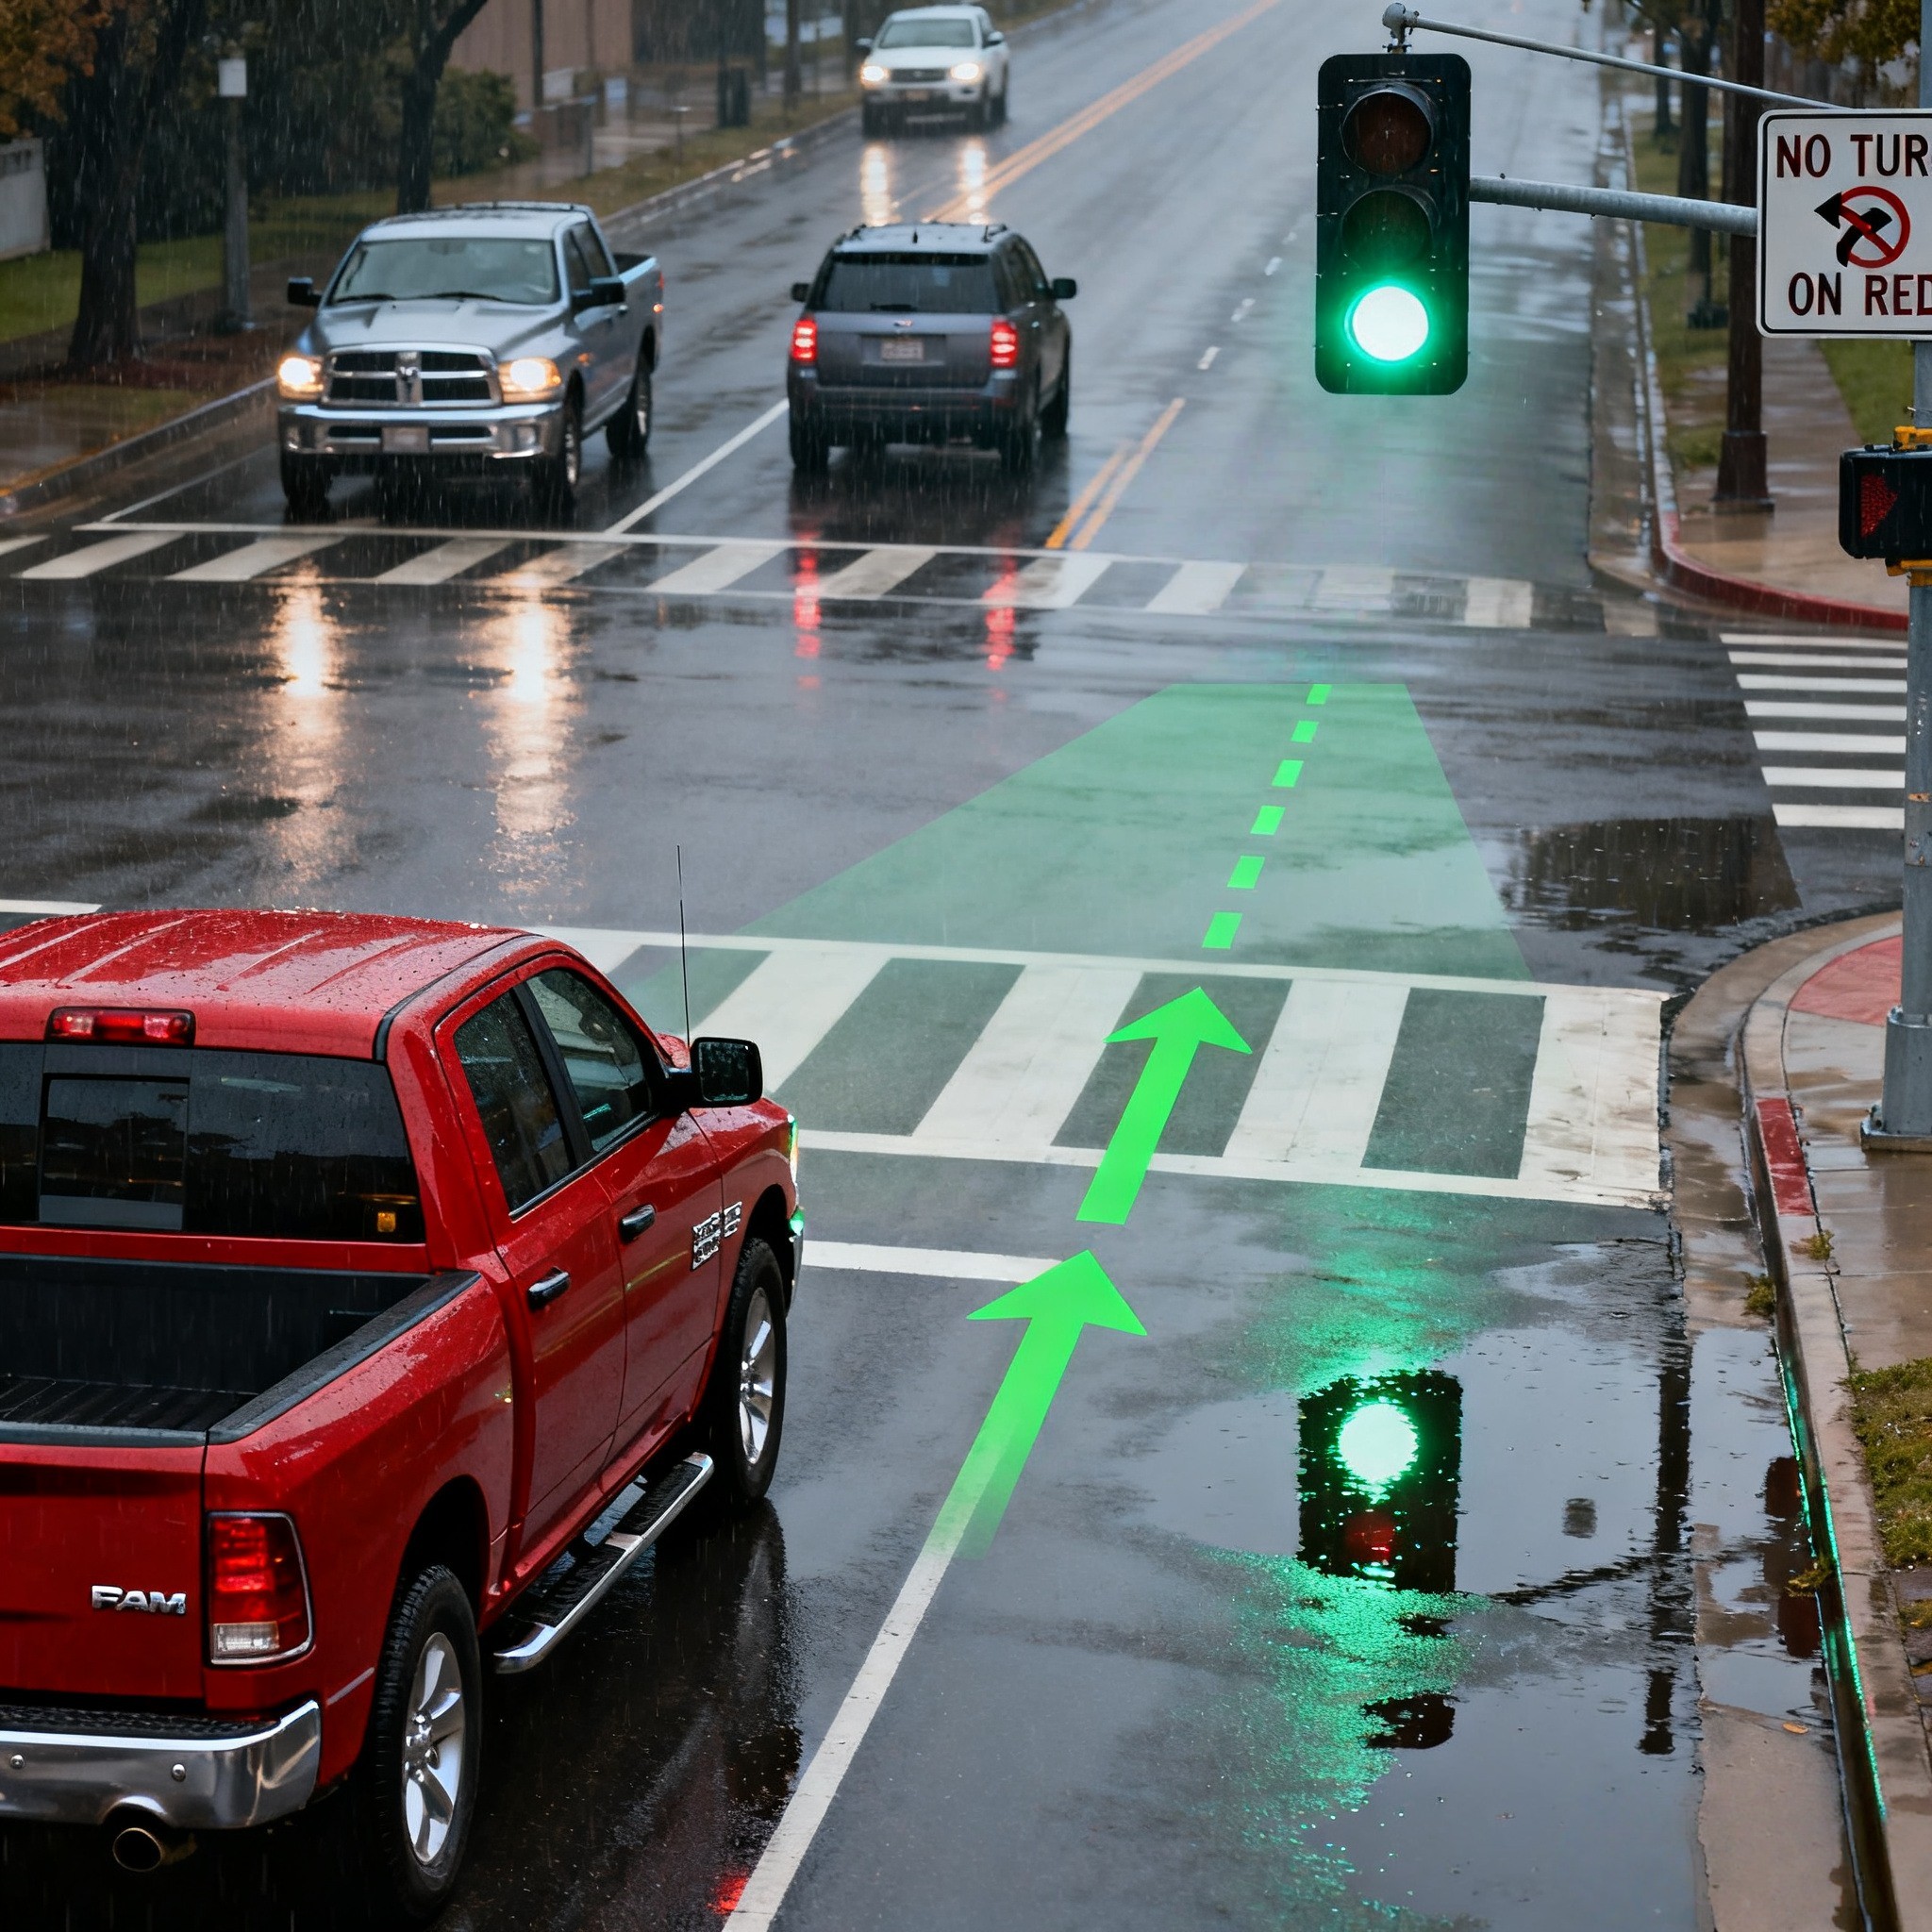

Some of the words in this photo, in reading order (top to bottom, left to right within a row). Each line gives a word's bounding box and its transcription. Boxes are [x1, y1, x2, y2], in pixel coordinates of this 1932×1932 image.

[1776, 134, 1831, 177] NO
[1788, 272, 1841, 316] ON
[1865, 274, 1932, 316] RED
